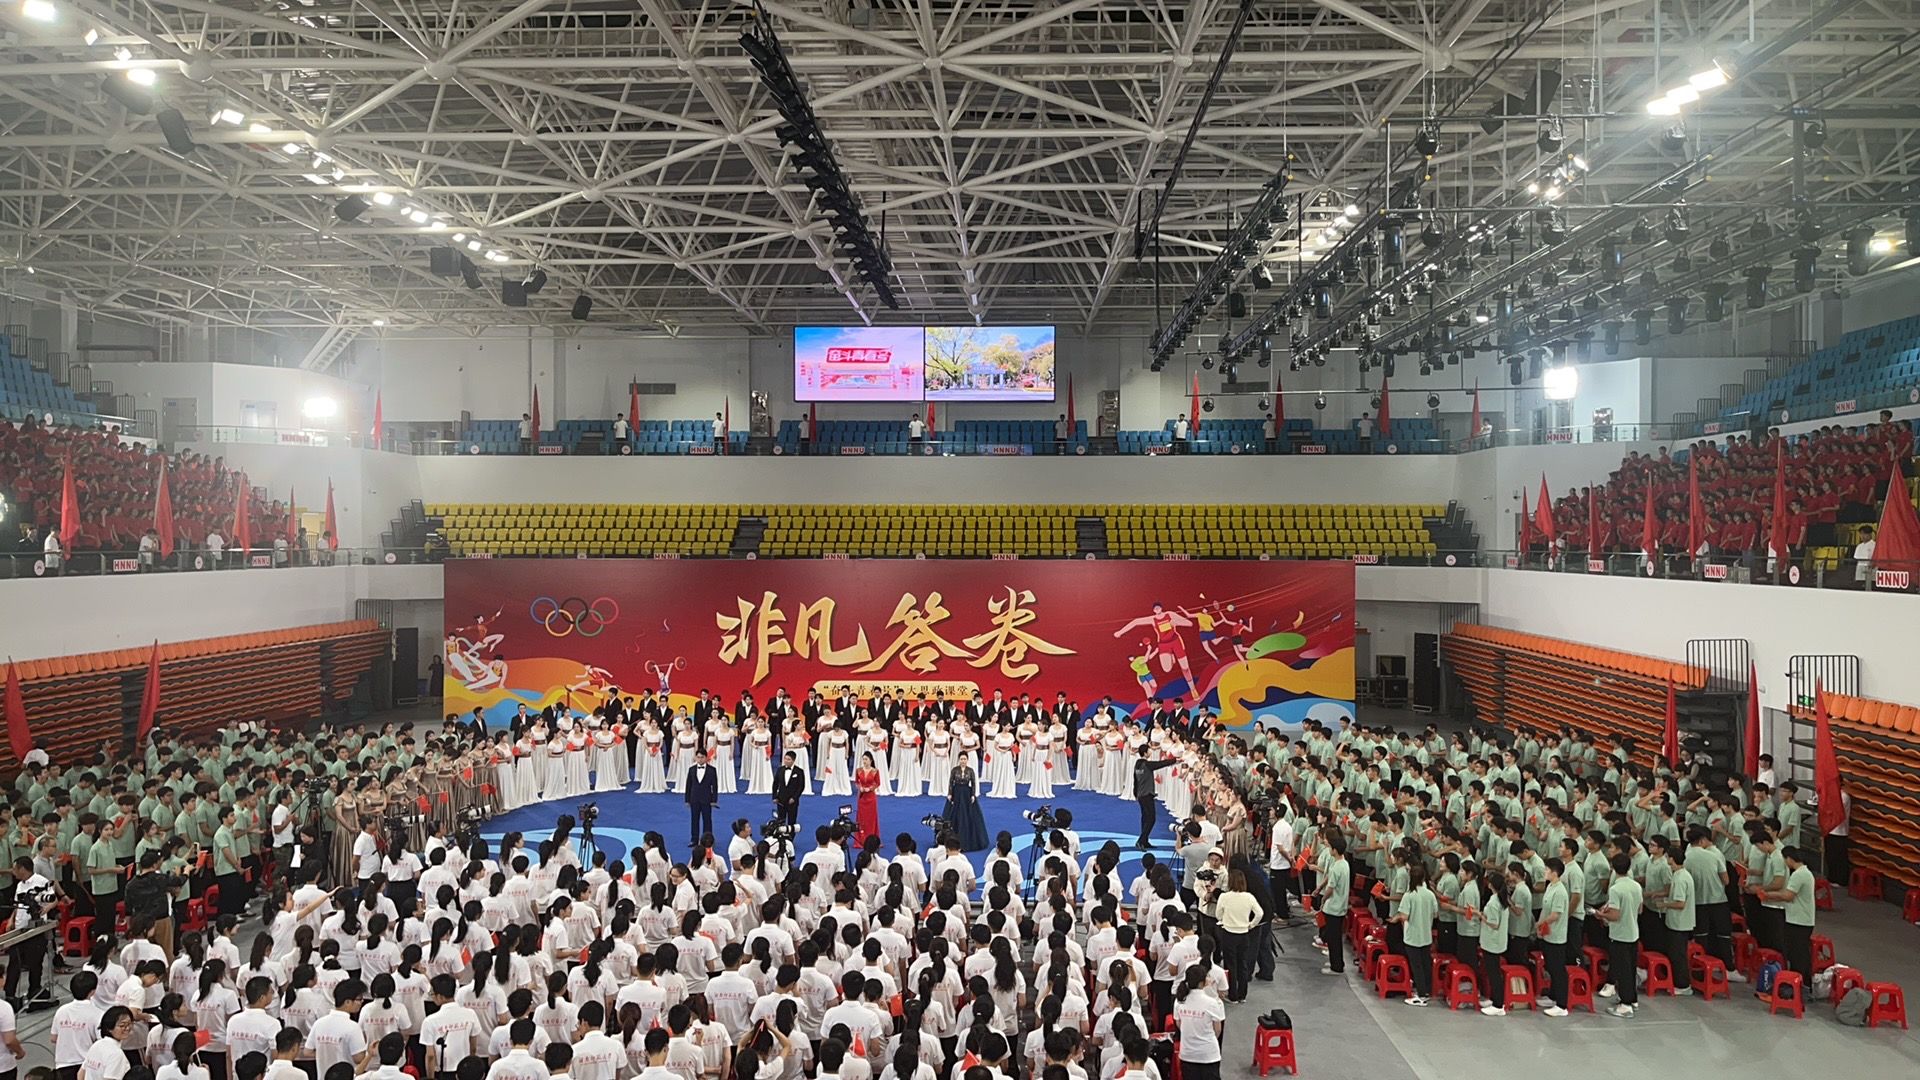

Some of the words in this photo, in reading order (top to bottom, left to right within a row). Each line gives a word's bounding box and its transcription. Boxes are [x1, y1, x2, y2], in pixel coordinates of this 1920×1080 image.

[1547, 432, 1572, 441] HNNU
[691, 446, 713, 454] HNNU
[993, 446, 1016, 454] HNNU
[1353, 555, 1377, 563] HNNU
[114, 560, 138, 571] HNNU
[1705, 565, 1727, 578] HNNU
[1876, 571, 1909, 589] HNNU
[716, 585, 1077, 687] 非凡答卷
